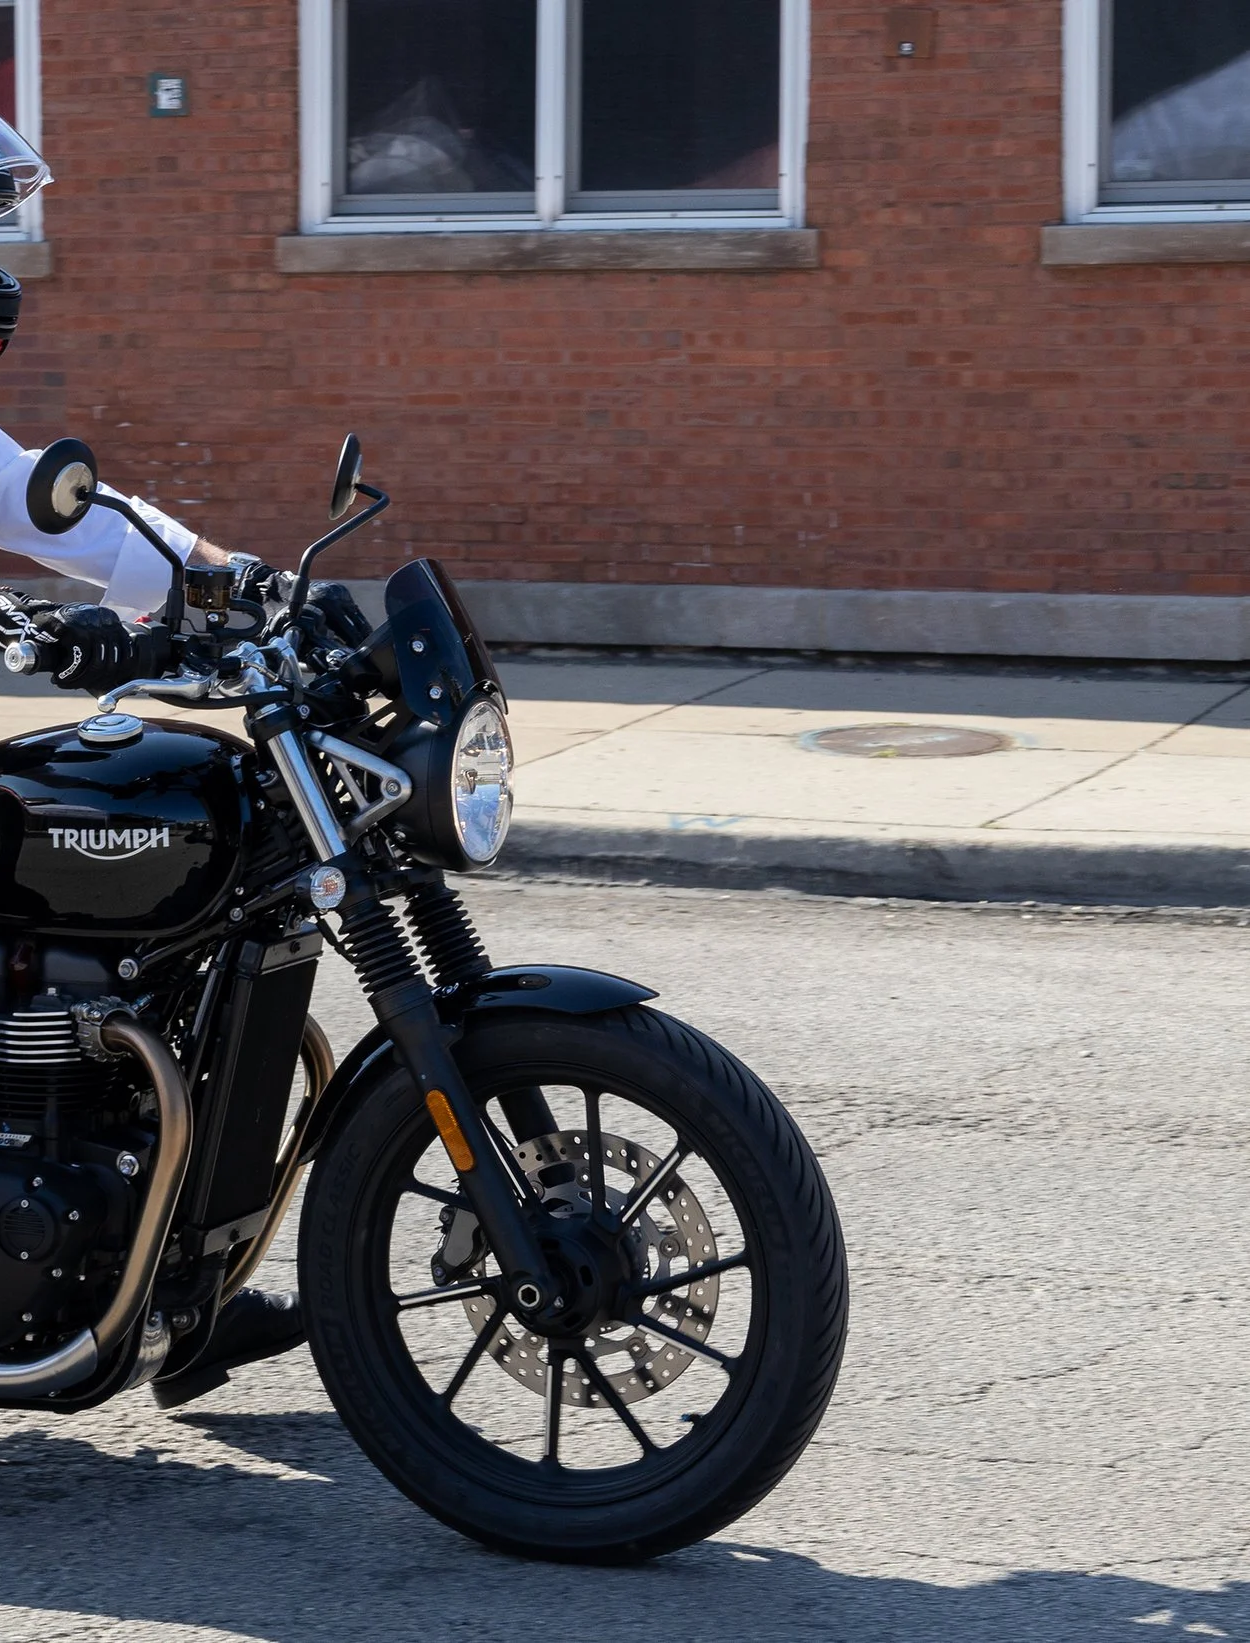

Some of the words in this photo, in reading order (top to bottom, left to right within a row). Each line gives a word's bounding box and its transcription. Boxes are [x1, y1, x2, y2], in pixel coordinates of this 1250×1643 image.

[48, 827, 170, 860] TRIUMPH
[321, 1141, 361, 1235] CLASSIC
[318, 1241, 337, 1311] ROAD
